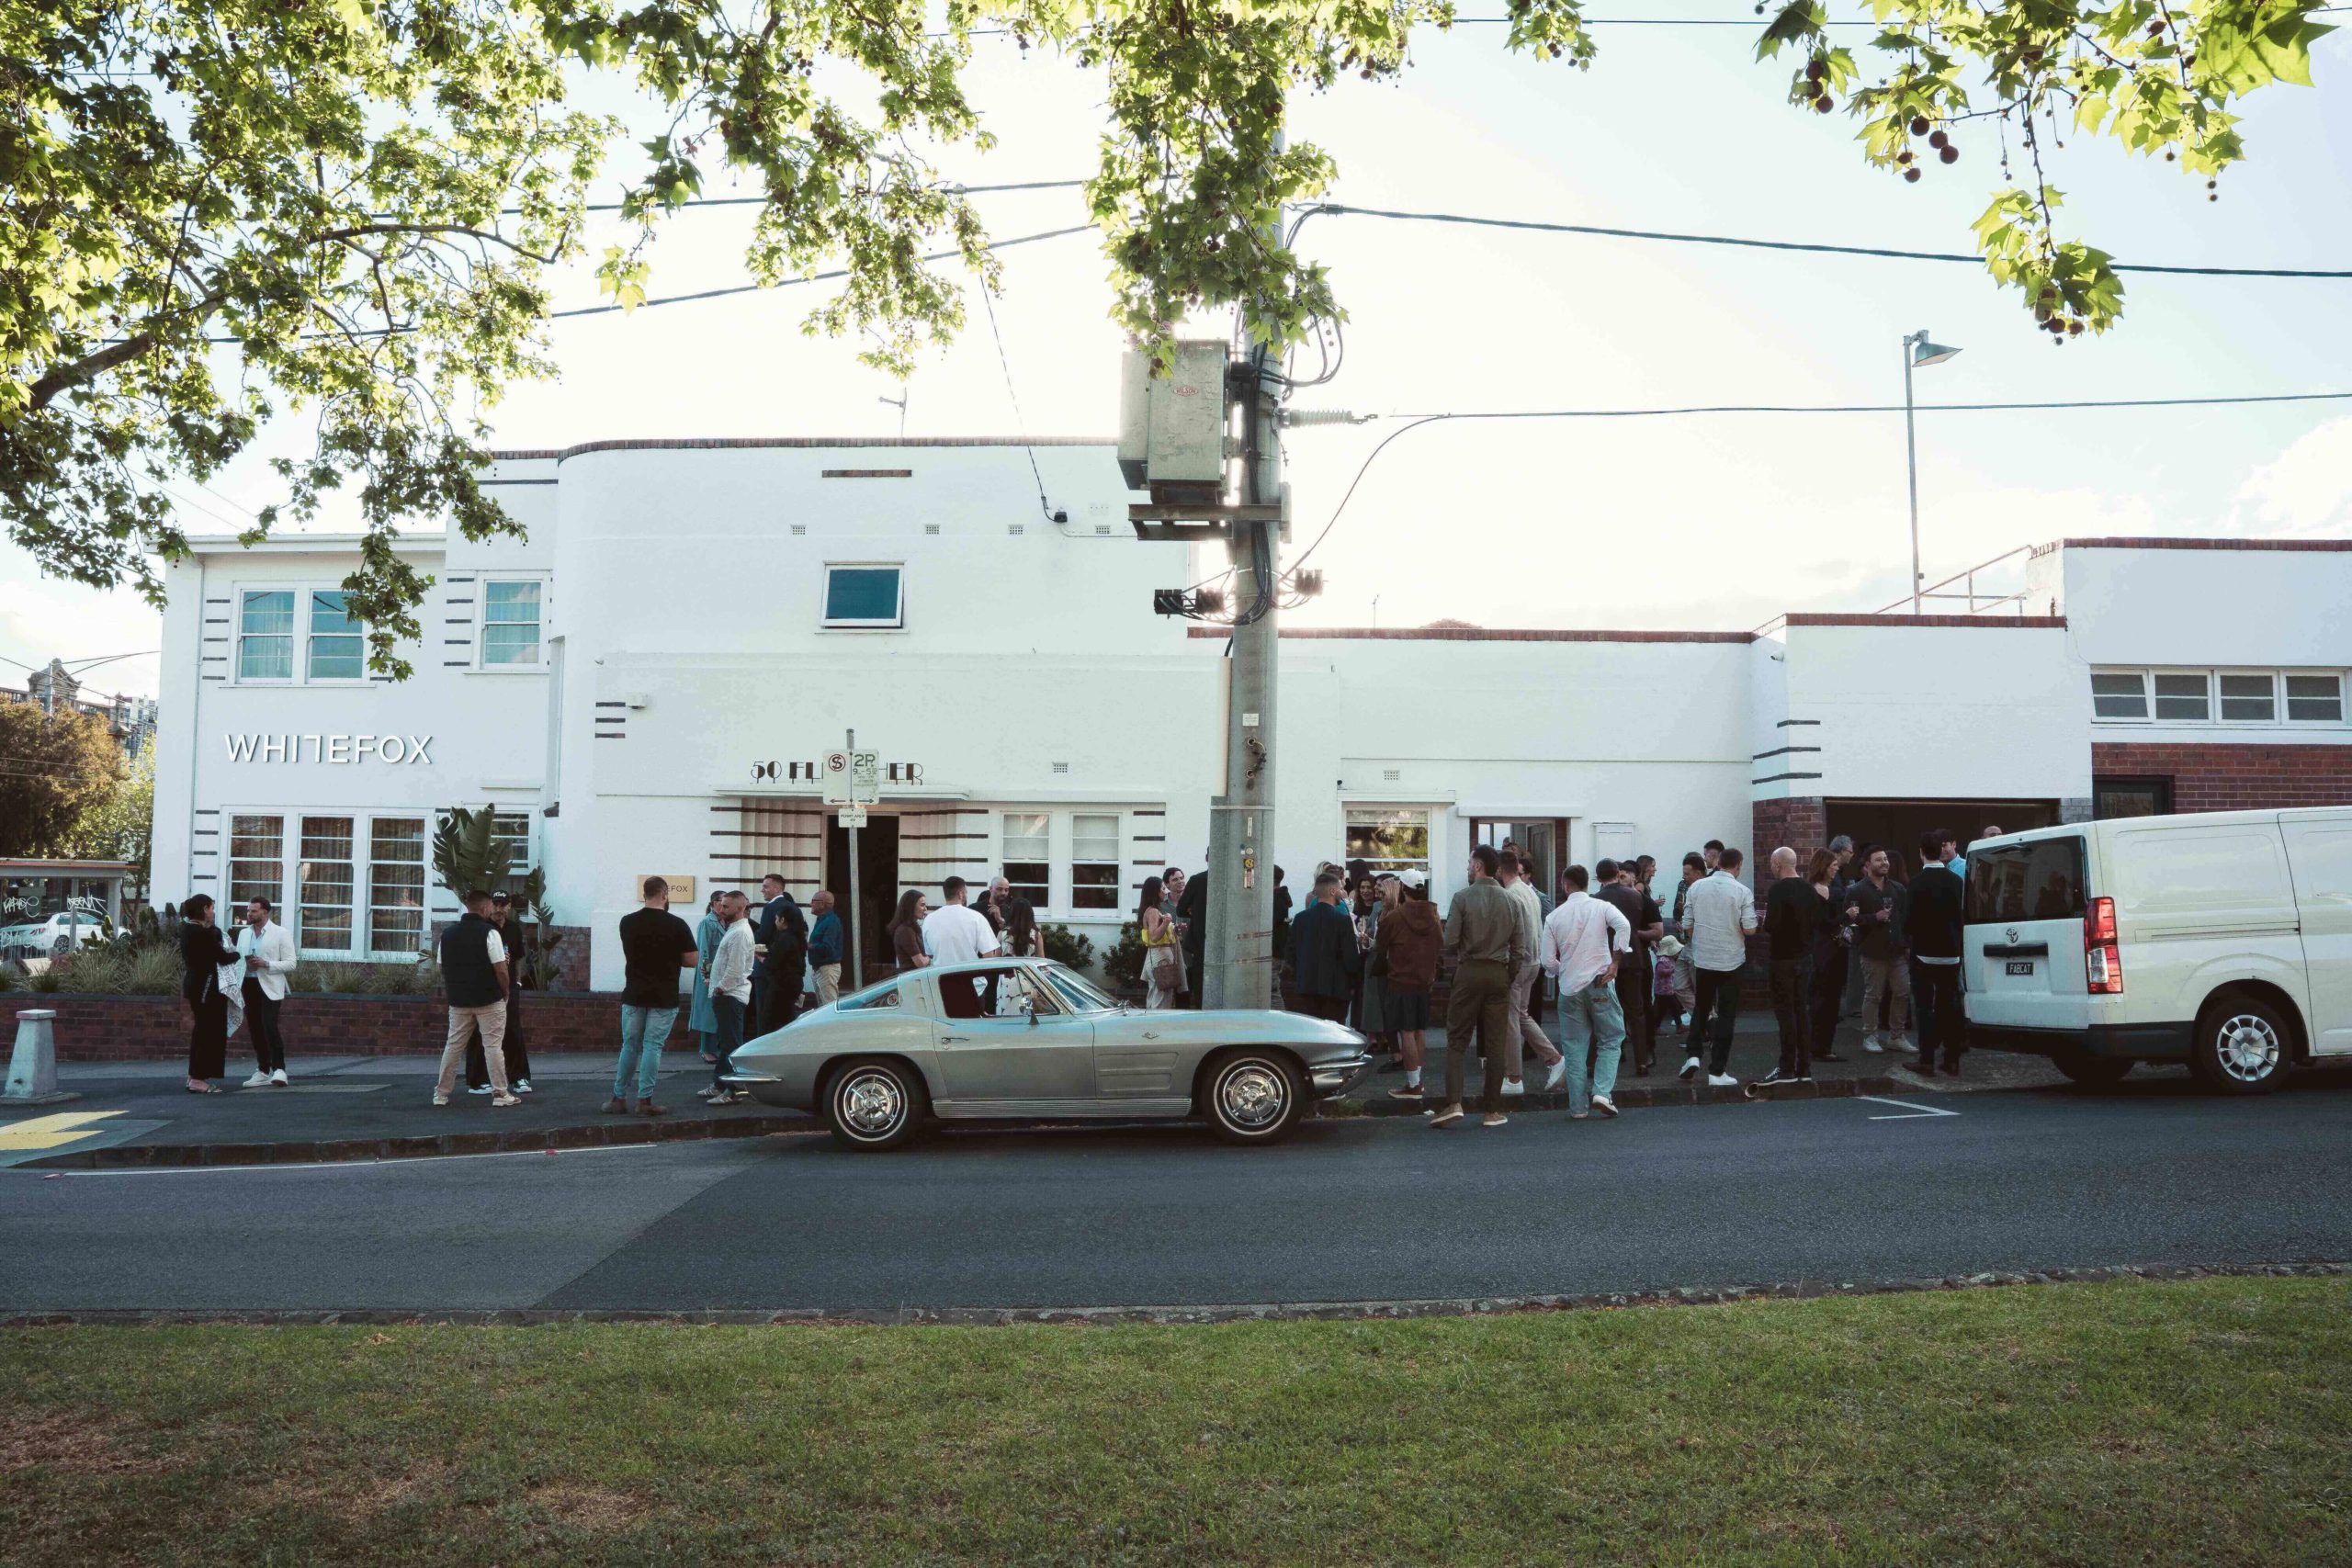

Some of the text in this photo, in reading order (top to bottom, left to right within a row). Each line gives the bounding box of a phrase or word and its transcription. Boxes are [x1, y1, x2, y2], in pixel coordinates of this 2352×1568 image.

[223, 734, 434, 764] WHITEFOX
[854, 753, 876, 767] 2P
[750, 761, 782, 784] 50
